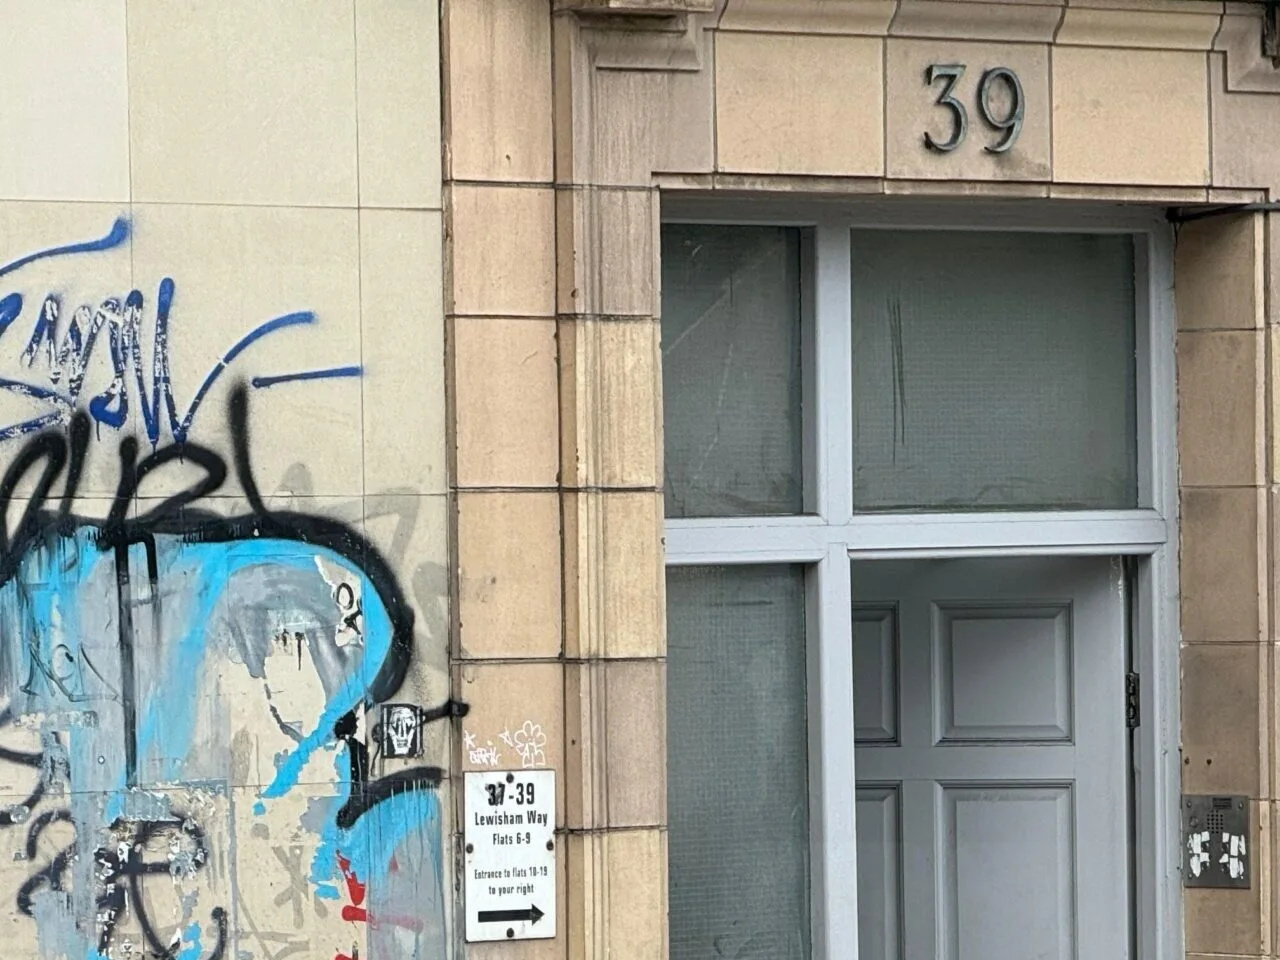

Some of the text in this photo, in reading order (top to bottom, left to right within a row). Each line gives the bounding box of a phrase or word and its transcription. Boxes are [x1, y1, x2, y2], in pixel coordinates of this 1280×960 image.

[922, 63, 1026, 154] 39
[486, 782, 536, 806] 37-39
[474, 809, 548, 827] Lewisham Way
[492, 832, 531, 845] Flats 6-9
[474, 868, 502, 880] Entrance
[504, 868, 511, 878] to
[512, 866, 527, 878] flats
[488, 883, 535, 897] to your right
